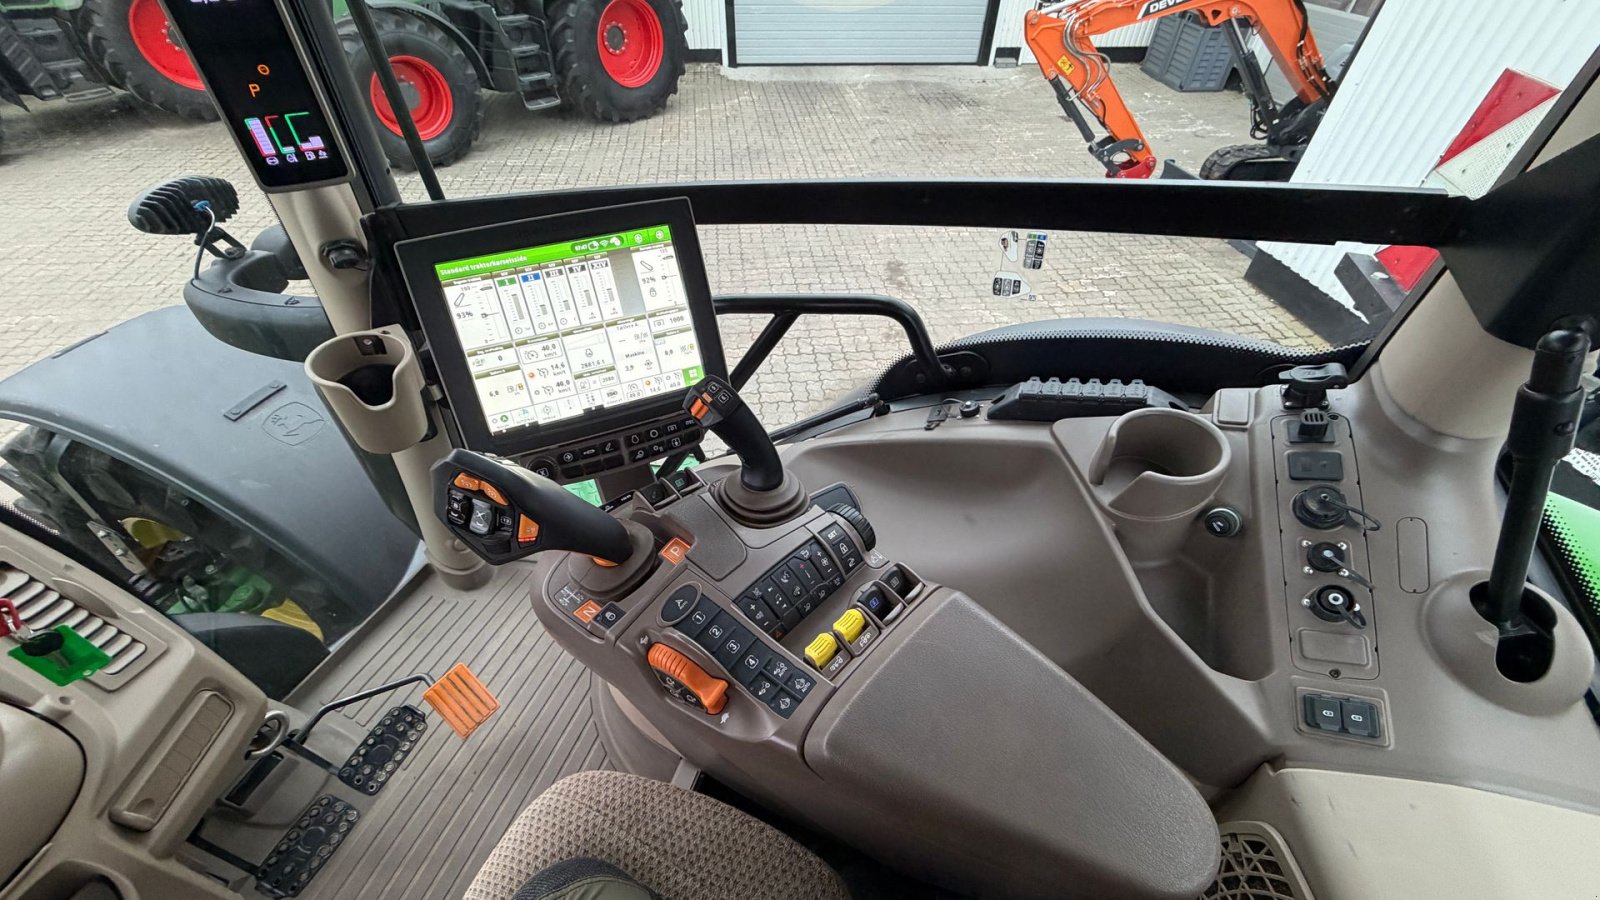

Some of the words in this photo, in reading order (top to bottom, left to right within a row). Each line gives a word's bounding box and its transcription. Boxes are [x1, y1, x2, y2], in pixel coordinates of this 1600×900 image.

[249, 83, 260, 97] P
[440, 265, 470, 276] Standard
[641, 276, 656, 284] 92%
[456, 310, 474, 319] 93%
[550, 362, 565, 370] 14,6
[828, 530, 838, 540] SET
[670, 546, 680, 557] P
[584, 606, 596, 617] N
[729, 642, 737, 650] 3
[748, 658, 756, 666] 4
